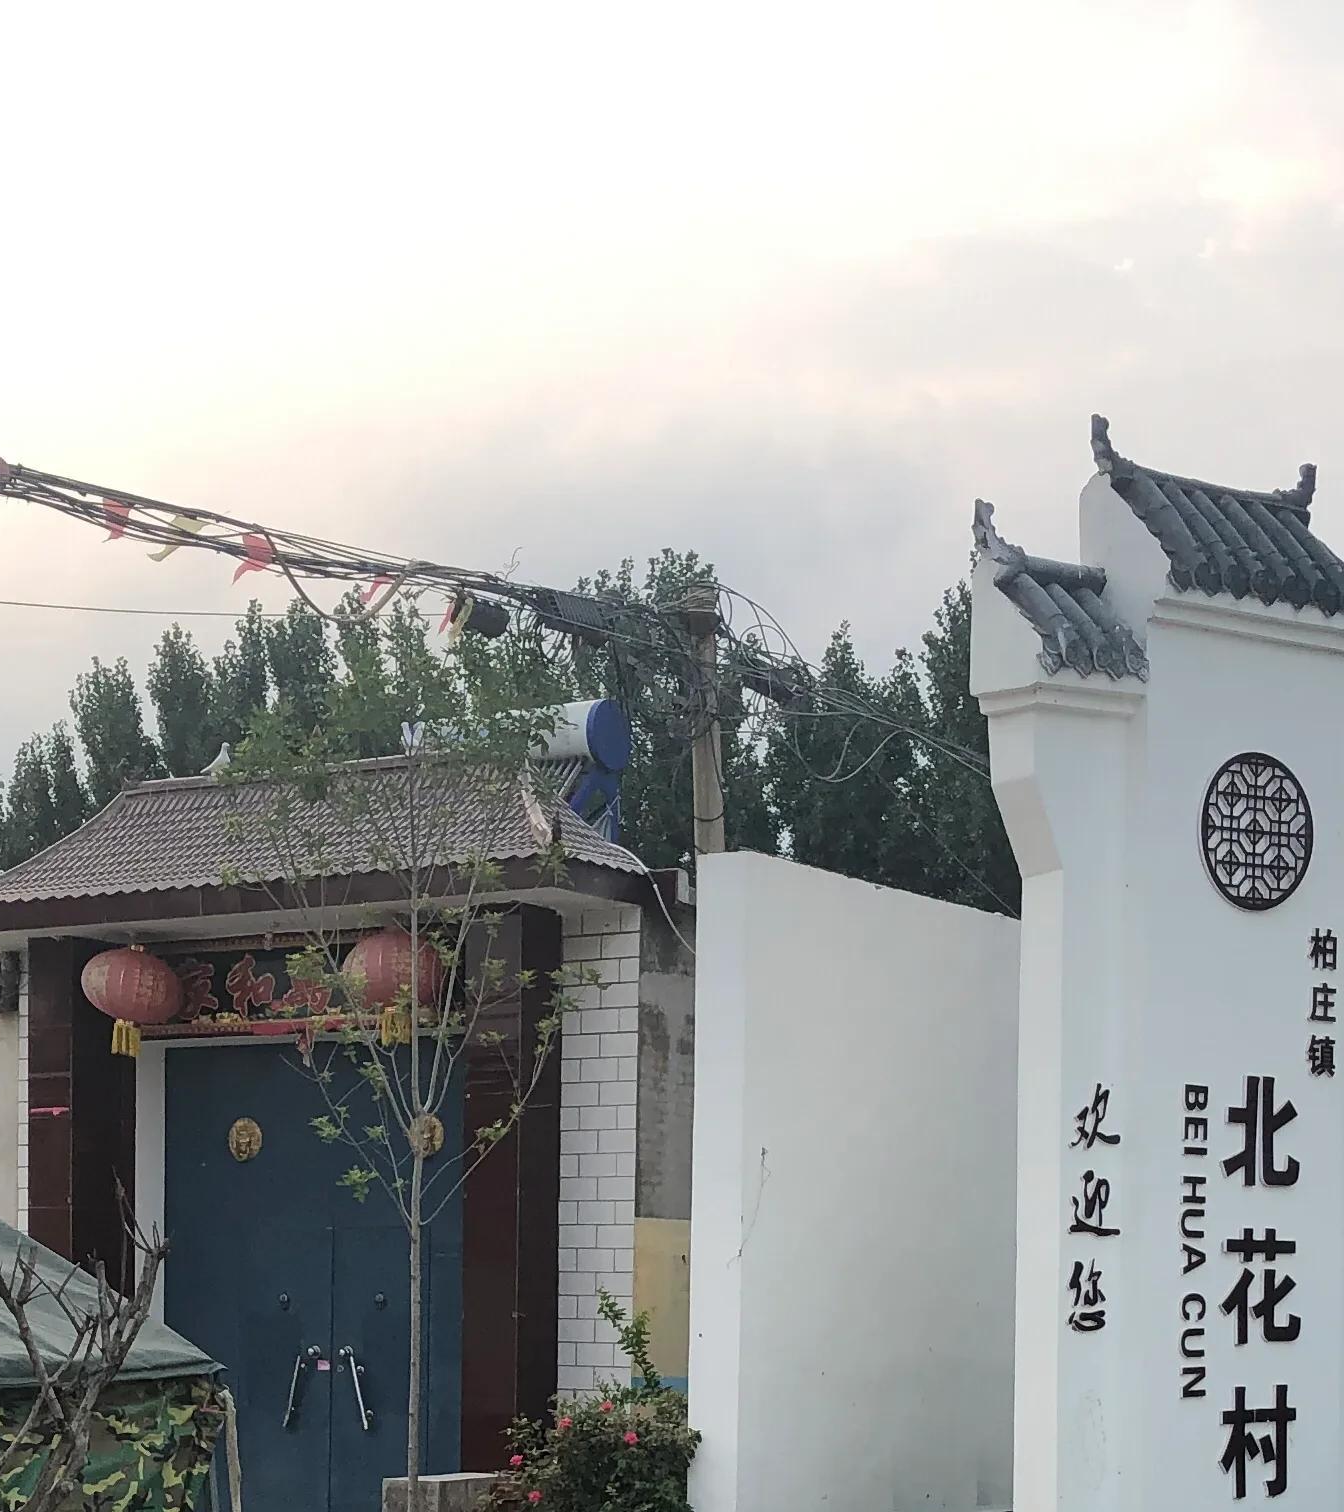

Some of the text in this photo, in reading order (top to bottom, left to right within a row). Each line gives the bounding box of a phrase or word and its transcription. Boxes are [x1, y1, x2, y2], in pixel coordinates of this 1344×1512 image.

[1306, 927, 1337, 1078] 柏庄镇
[1069, 1082, 1121, 1333] 欢迎您
[1180, 1083, 1209, 1399] BEI HUA CUN
[1220, 1075, 1301, 1500] 北花村
